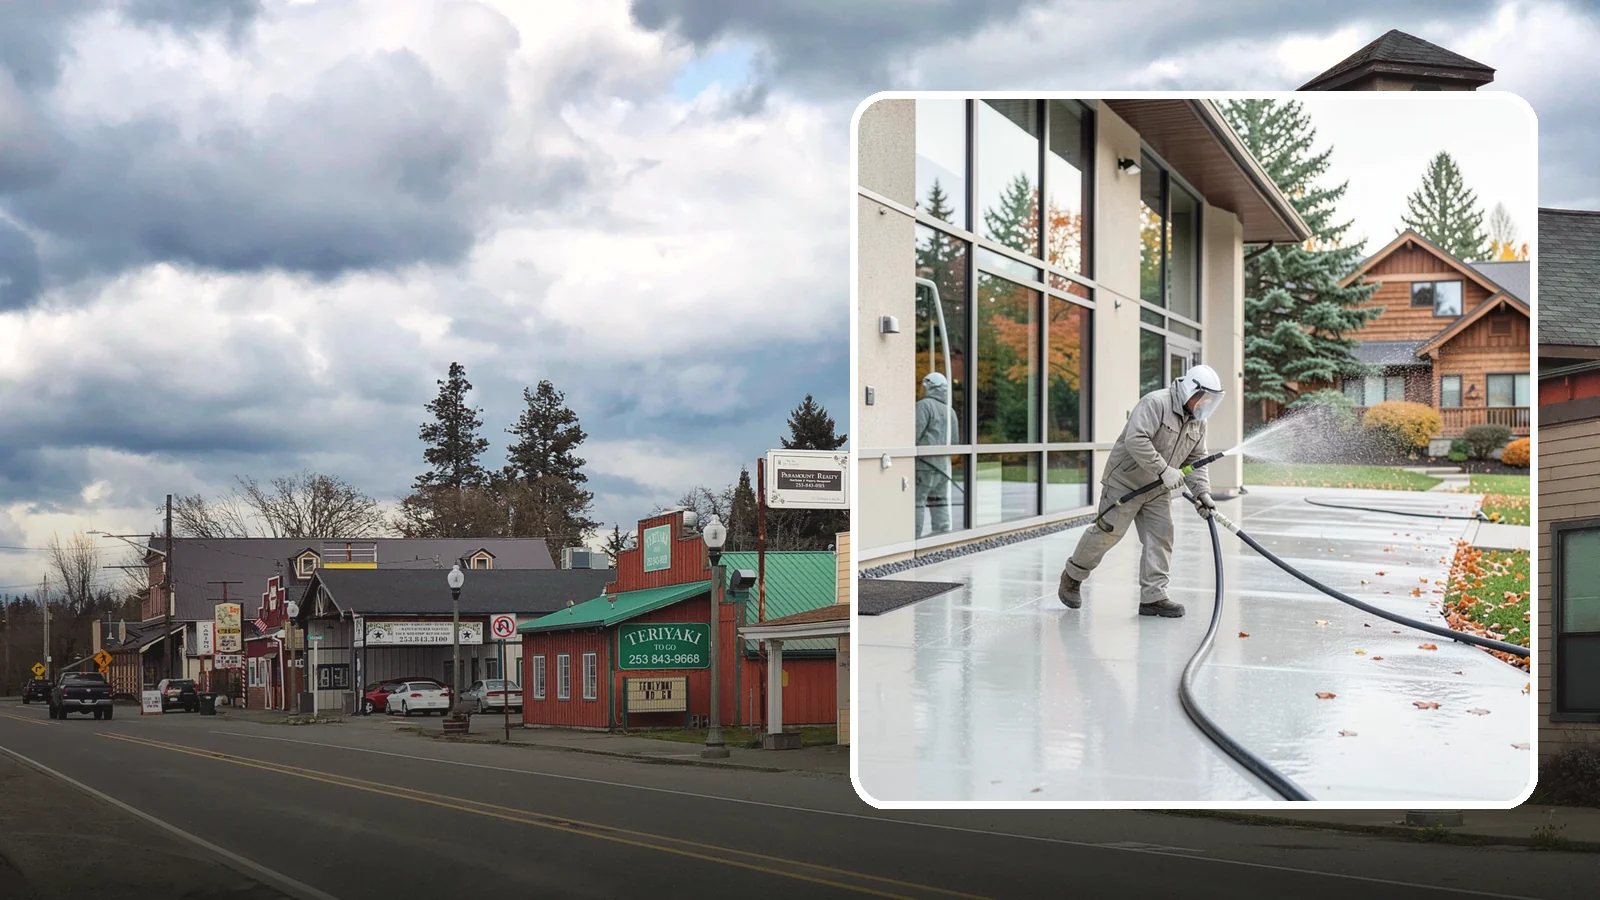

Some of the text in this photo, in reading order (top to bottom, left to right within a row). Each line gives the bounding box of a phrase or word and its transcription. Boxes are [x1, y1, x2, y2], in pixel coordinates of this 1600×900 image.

[625, 628, 702, 645] TERIYAKI
[629, 654, 700, 664] 253 843-9668
[639, 682, 672, 690] TERIYAKI
